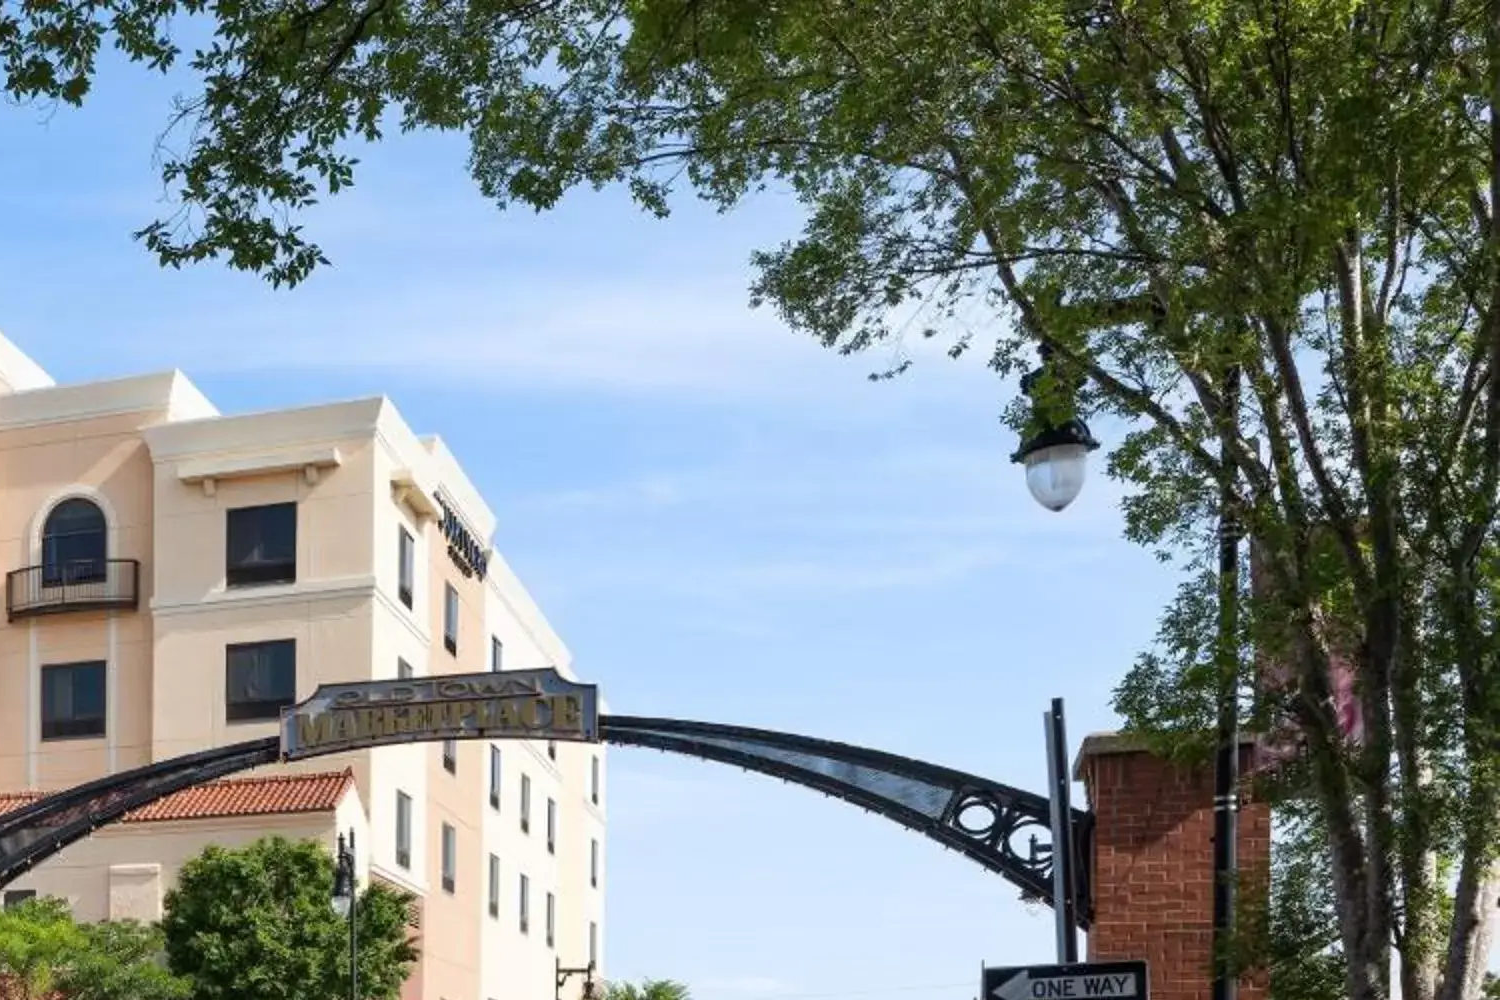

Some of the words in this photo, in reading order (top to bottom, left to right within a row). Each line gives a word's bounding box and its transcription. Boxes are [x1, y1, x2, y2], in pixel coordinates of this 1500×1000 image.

[336, 685, 414, 704] OLD
[421, 676, 541, 700] TOWN
[296, 693, 581, 747] MARKETPLACE
[1031, 978, 1076, 998] ONE
[1083, 976, 1129, 996] WAY
